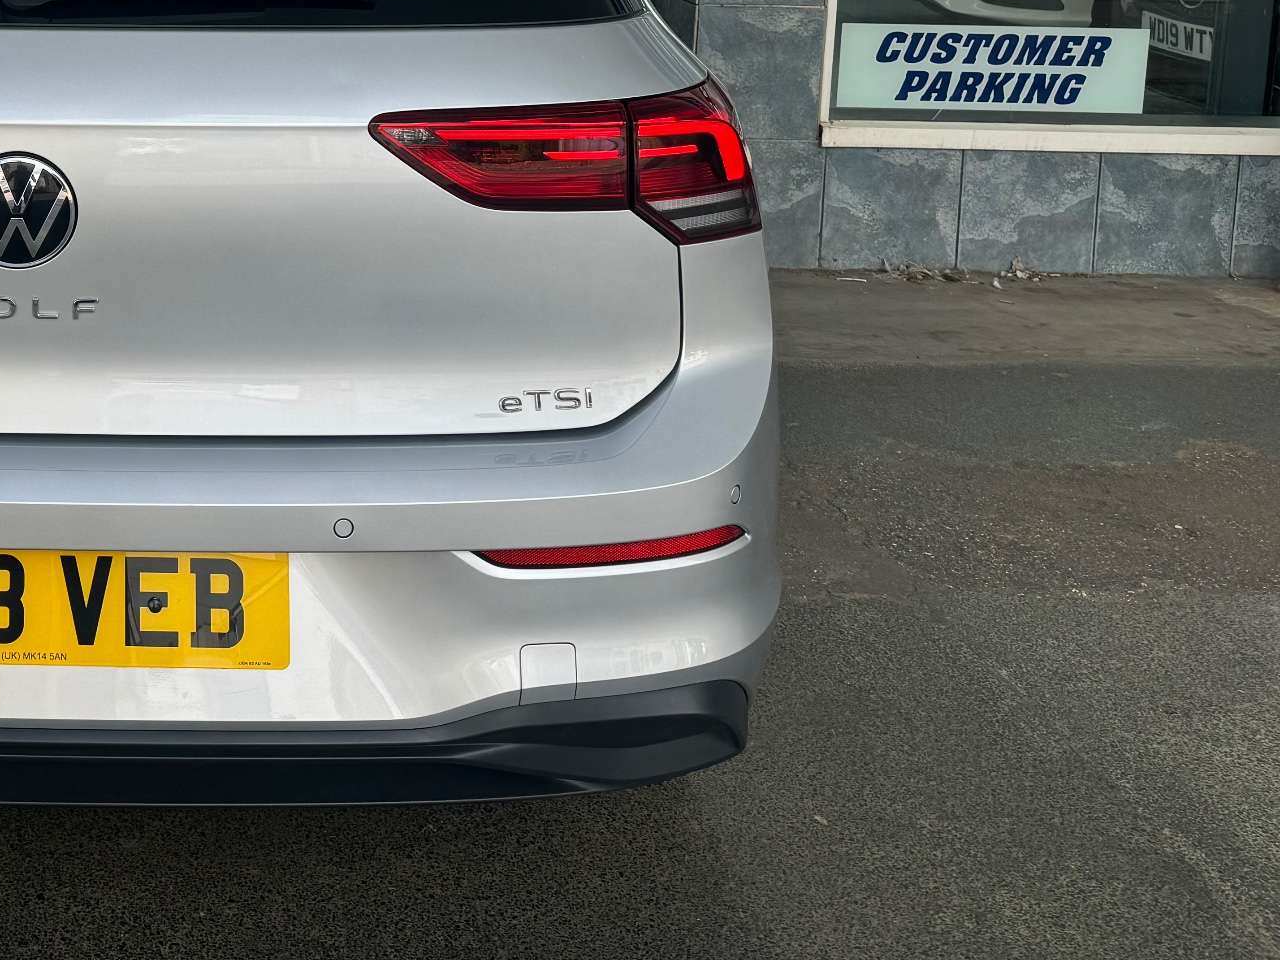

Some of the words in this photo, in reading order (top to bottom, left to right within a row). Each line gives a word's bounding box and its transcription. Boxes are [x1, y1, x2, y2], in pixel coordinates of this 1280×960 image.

[875, 31, 1113, 67] CUSTOMER
[894, 70, 1087, 105] PARKING
[60, 555, 244, 649] VEB
[1, 651, 20, 661] (UK)
[22, 651, 47, 660] MK14
[49, 652, 67, 661] 5AN
